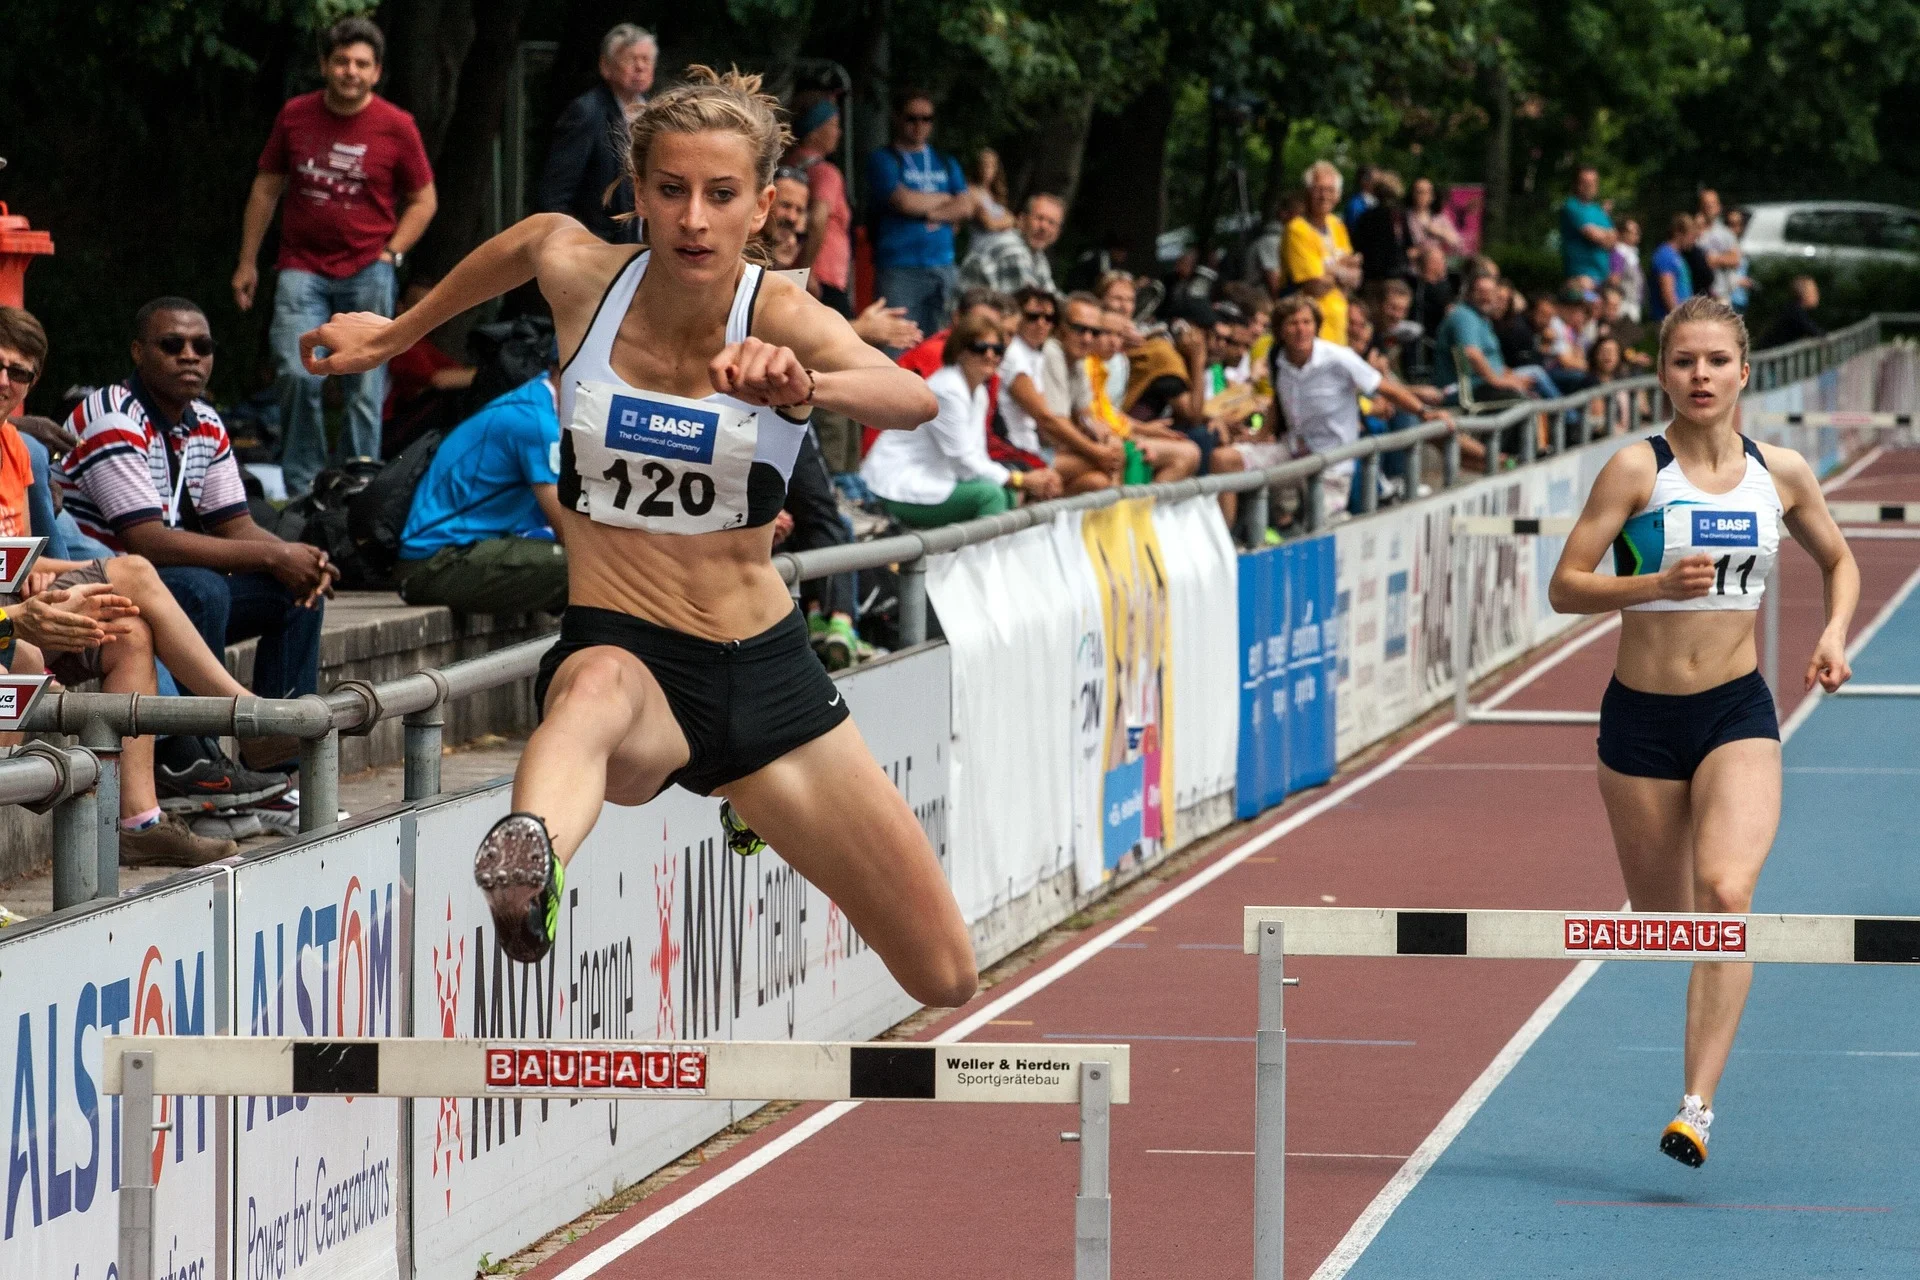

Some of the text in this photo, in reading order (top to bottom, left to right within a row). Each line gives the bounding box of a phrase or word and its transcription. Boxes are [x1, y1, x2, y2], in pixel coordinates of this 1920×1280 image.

[649, 414, 705, 439] BASF
[619, 431, 701, 454] The Chemical Company
[603, 458, 716, 517] 120
[1717, 518, 1751, 531] BASF
[682, 832, 747, 1040] MVV
[1567, 922, 1743, 948] BAUHAUS
[246, 875, 393, 1132] ALSTOM
[471, 925, 557, 1160] MVV
[490, 1053, 701, 1084] BAUHAUS
[946, 1058, 1071, 1071] Weller & Herden
[957, 1072, 1060, 1086] Sportgerätebau
[4, 945, 206, 1241] ALSTOM
[247, 1195, 290, 1280] Power
[293, 1155, 312, 1269] for
[314, 1136, 390, 1256] Generations
